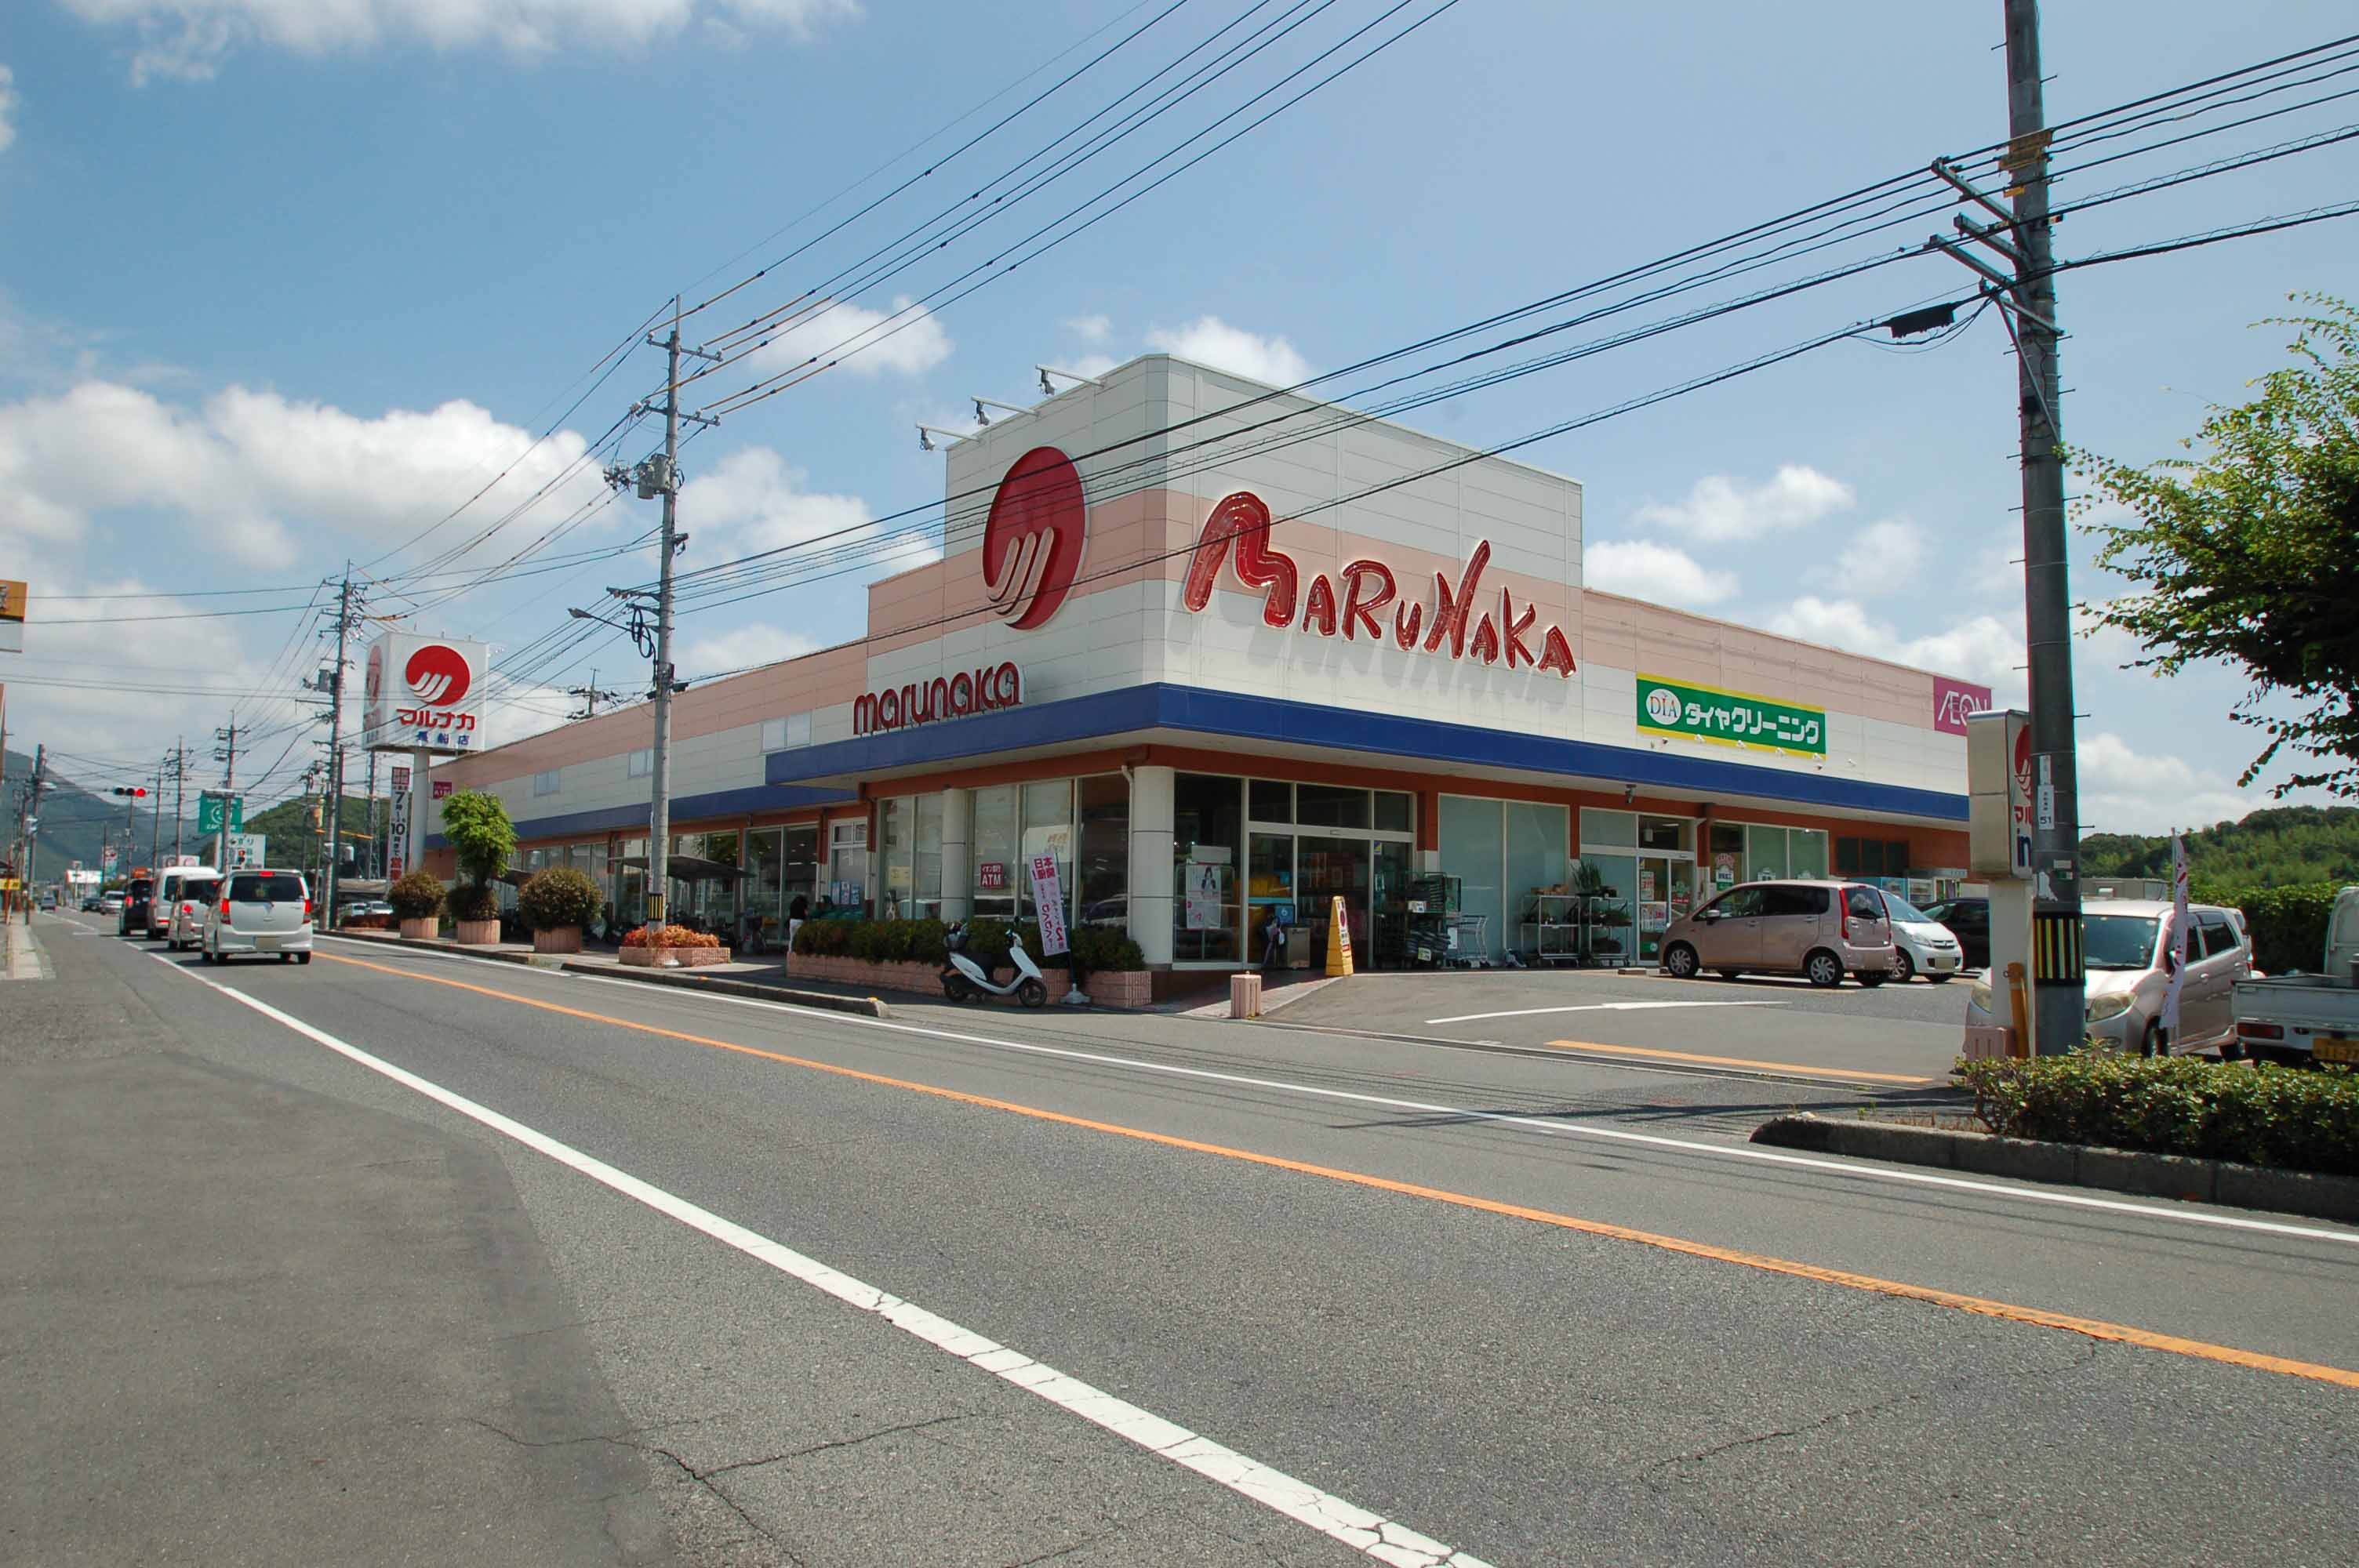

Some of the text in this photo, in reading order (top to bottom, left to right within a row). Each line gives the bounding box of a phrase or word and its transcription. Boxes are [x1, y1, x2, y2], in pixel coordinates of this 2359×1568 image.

[1183, 491, 1576, 679] MARUNAKA
[396, 708, 476, 731] マルナカ
[853, 662, 1023, 735] marunaka
[1650, 695, 1819, 744] DIA ダイヤクリーニング
[982, 874, 1001, 885] ATM
